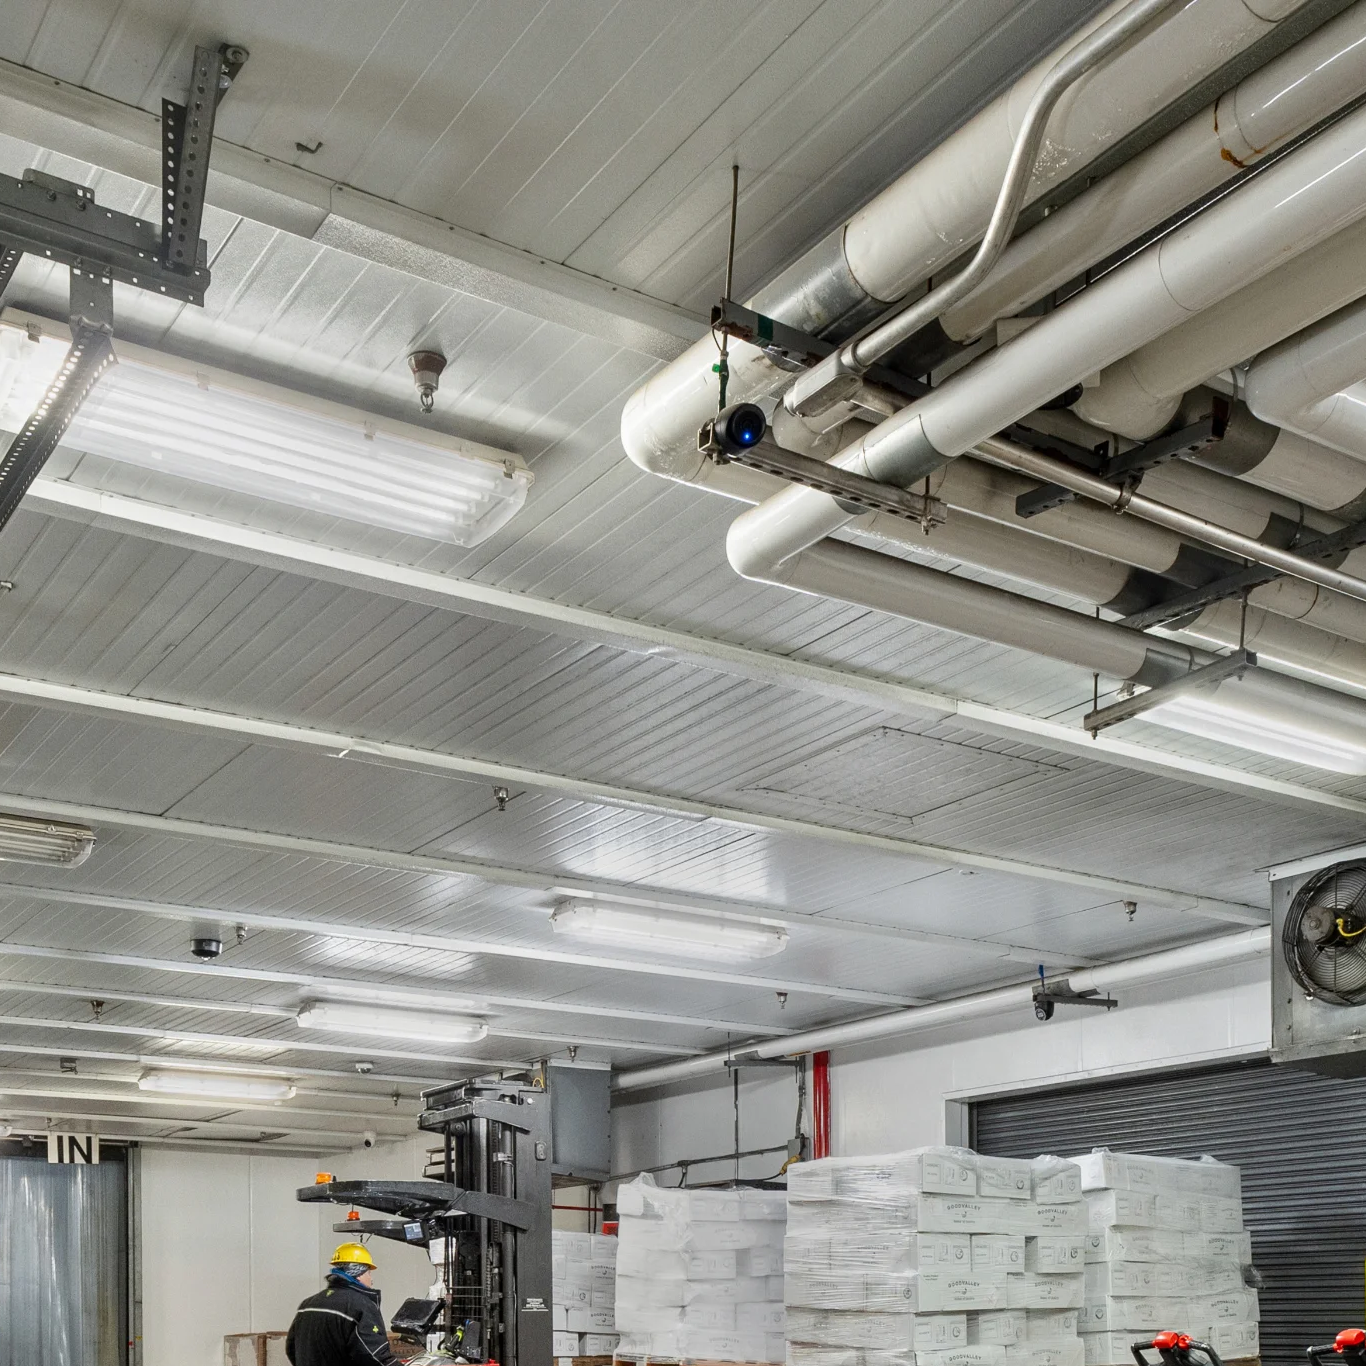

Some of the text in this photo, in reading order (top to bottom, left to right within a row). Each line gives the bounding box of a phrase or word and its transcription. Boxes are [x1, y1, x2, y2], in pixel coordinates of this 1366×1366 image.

[56, 1135, 93, 1164] IN
[948, 1280, 980, 1288] GOODVALLEY
[949, 1354, 982, 1362] GOODVALLEY
